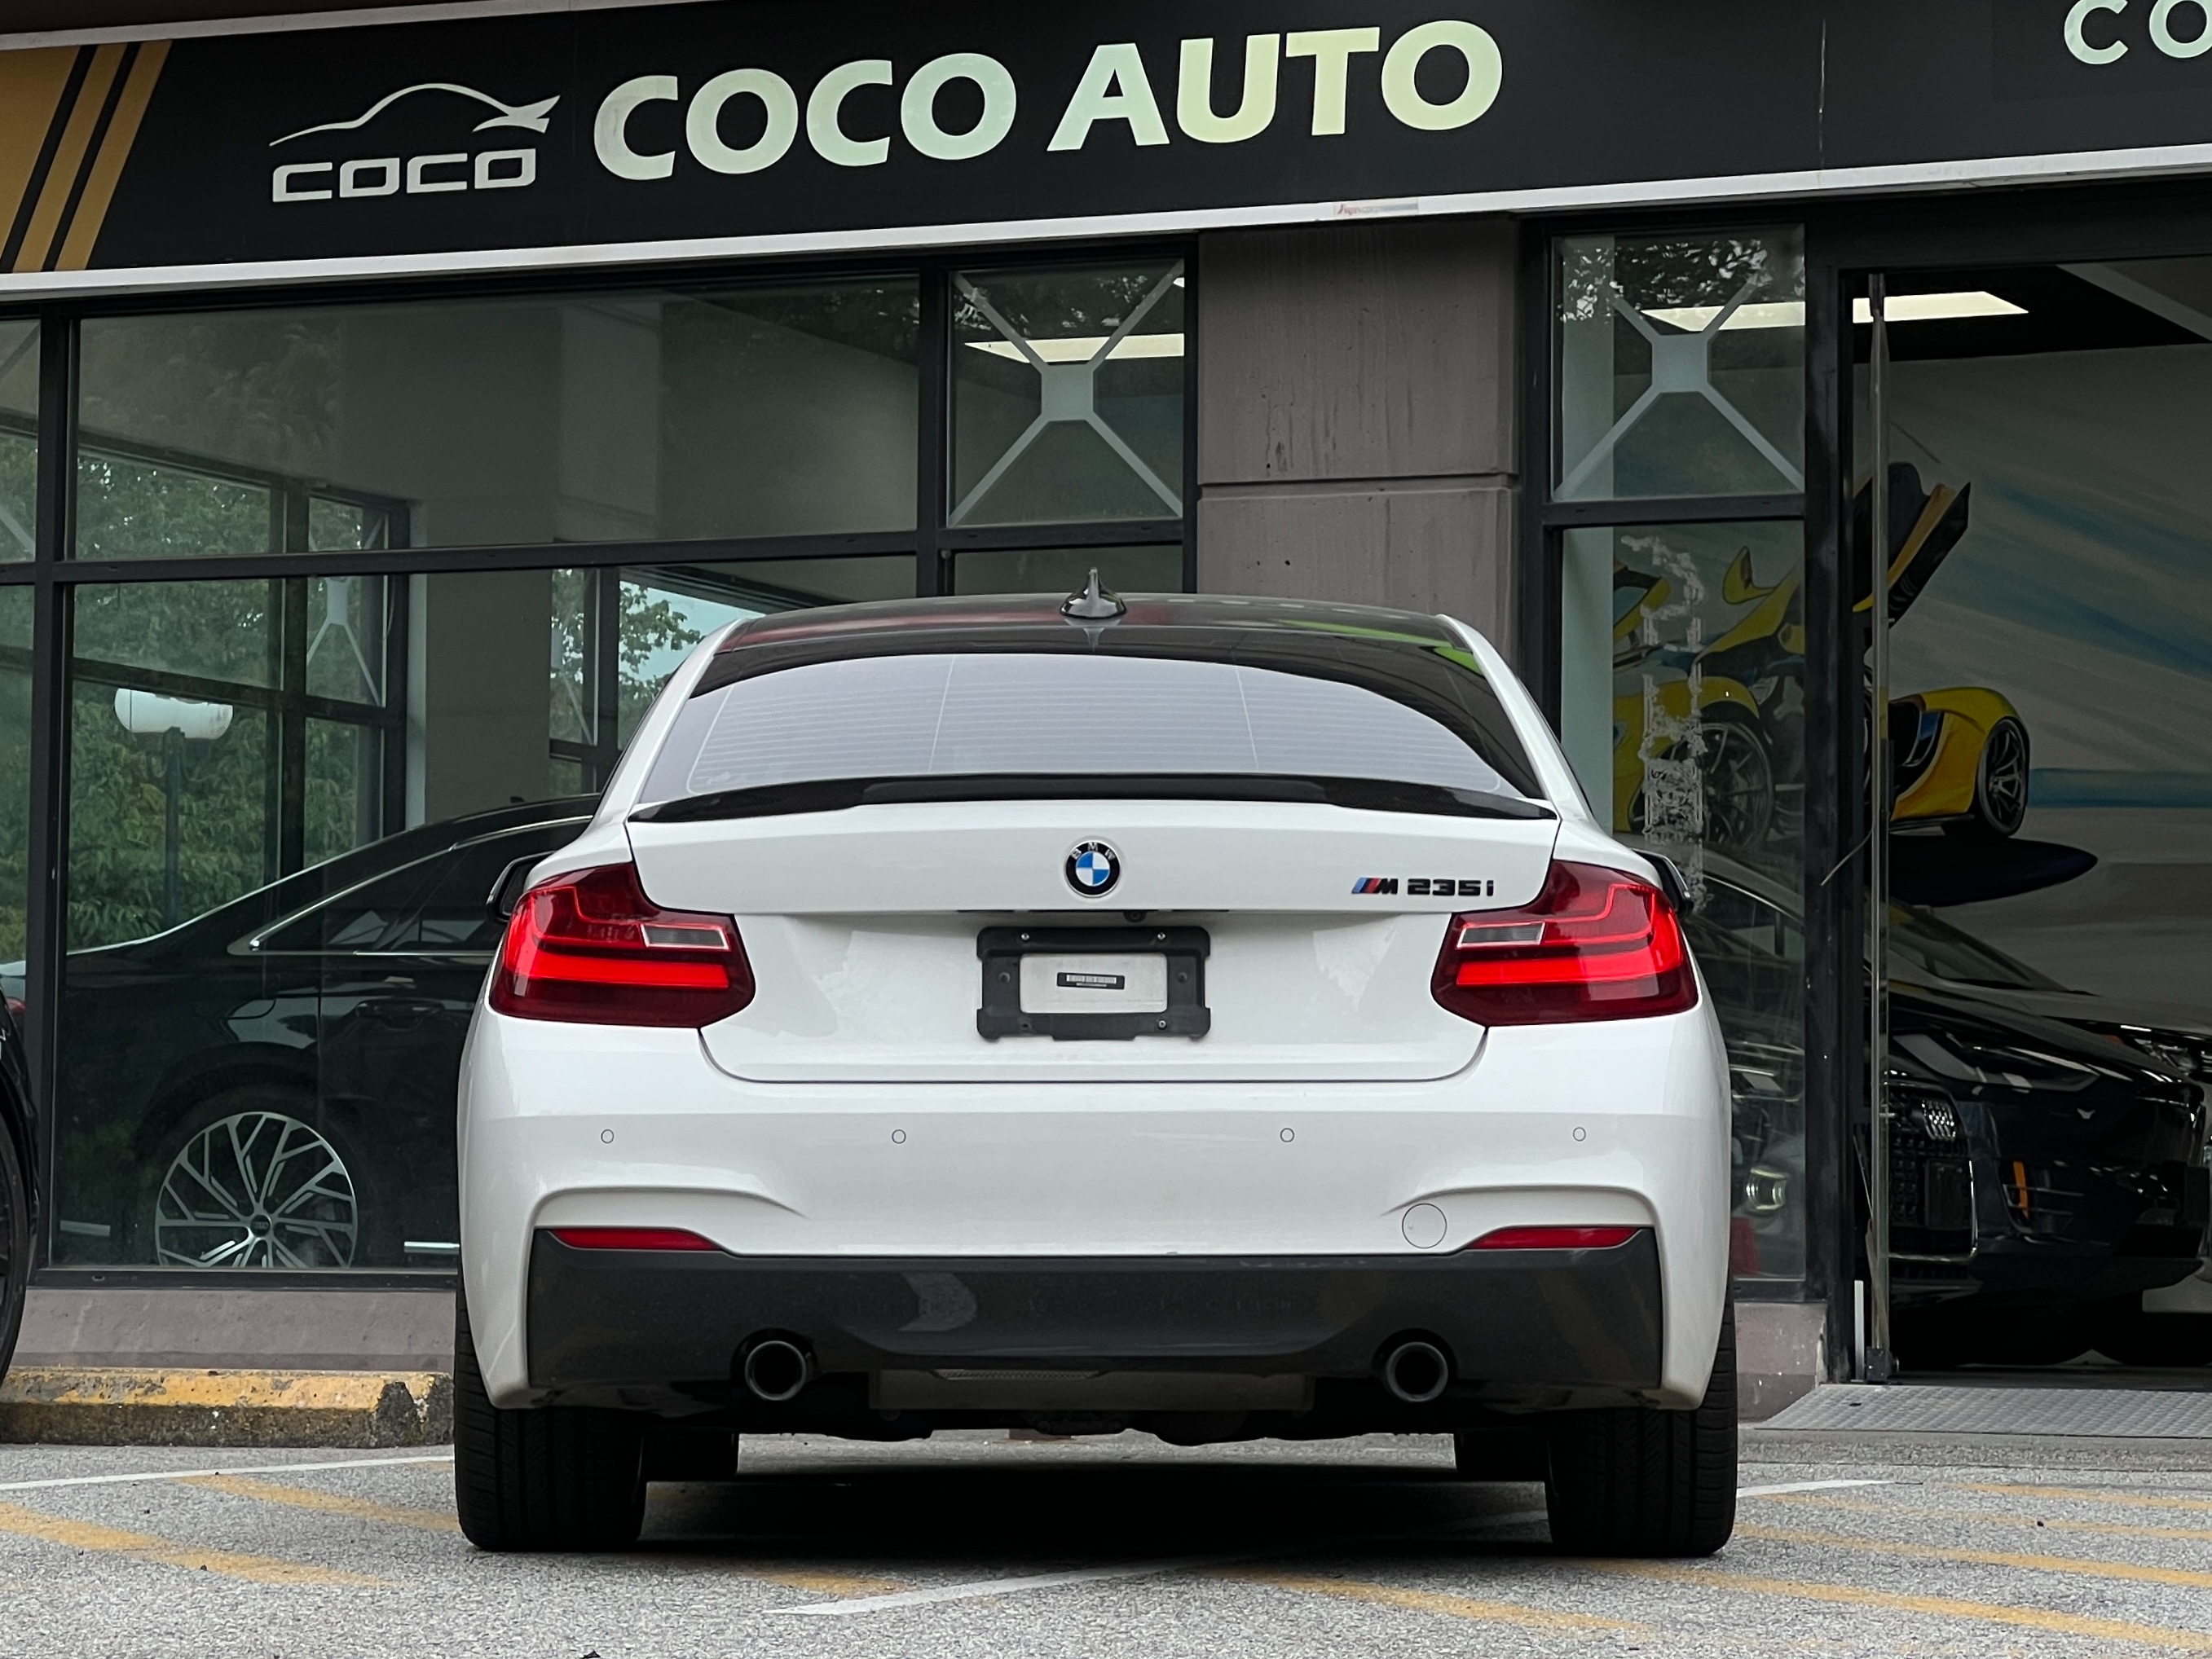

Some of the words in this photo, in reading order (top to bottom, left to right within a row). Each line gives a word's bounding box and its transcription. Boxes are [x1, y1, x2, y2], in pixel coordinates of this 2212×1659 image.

[594, 53, 1016, 180] COCO
[1047, 20, 1502, 151] AUTO
[270, 145, 535, 201] COCO
[1070, 842, 1116, 860] BMW
